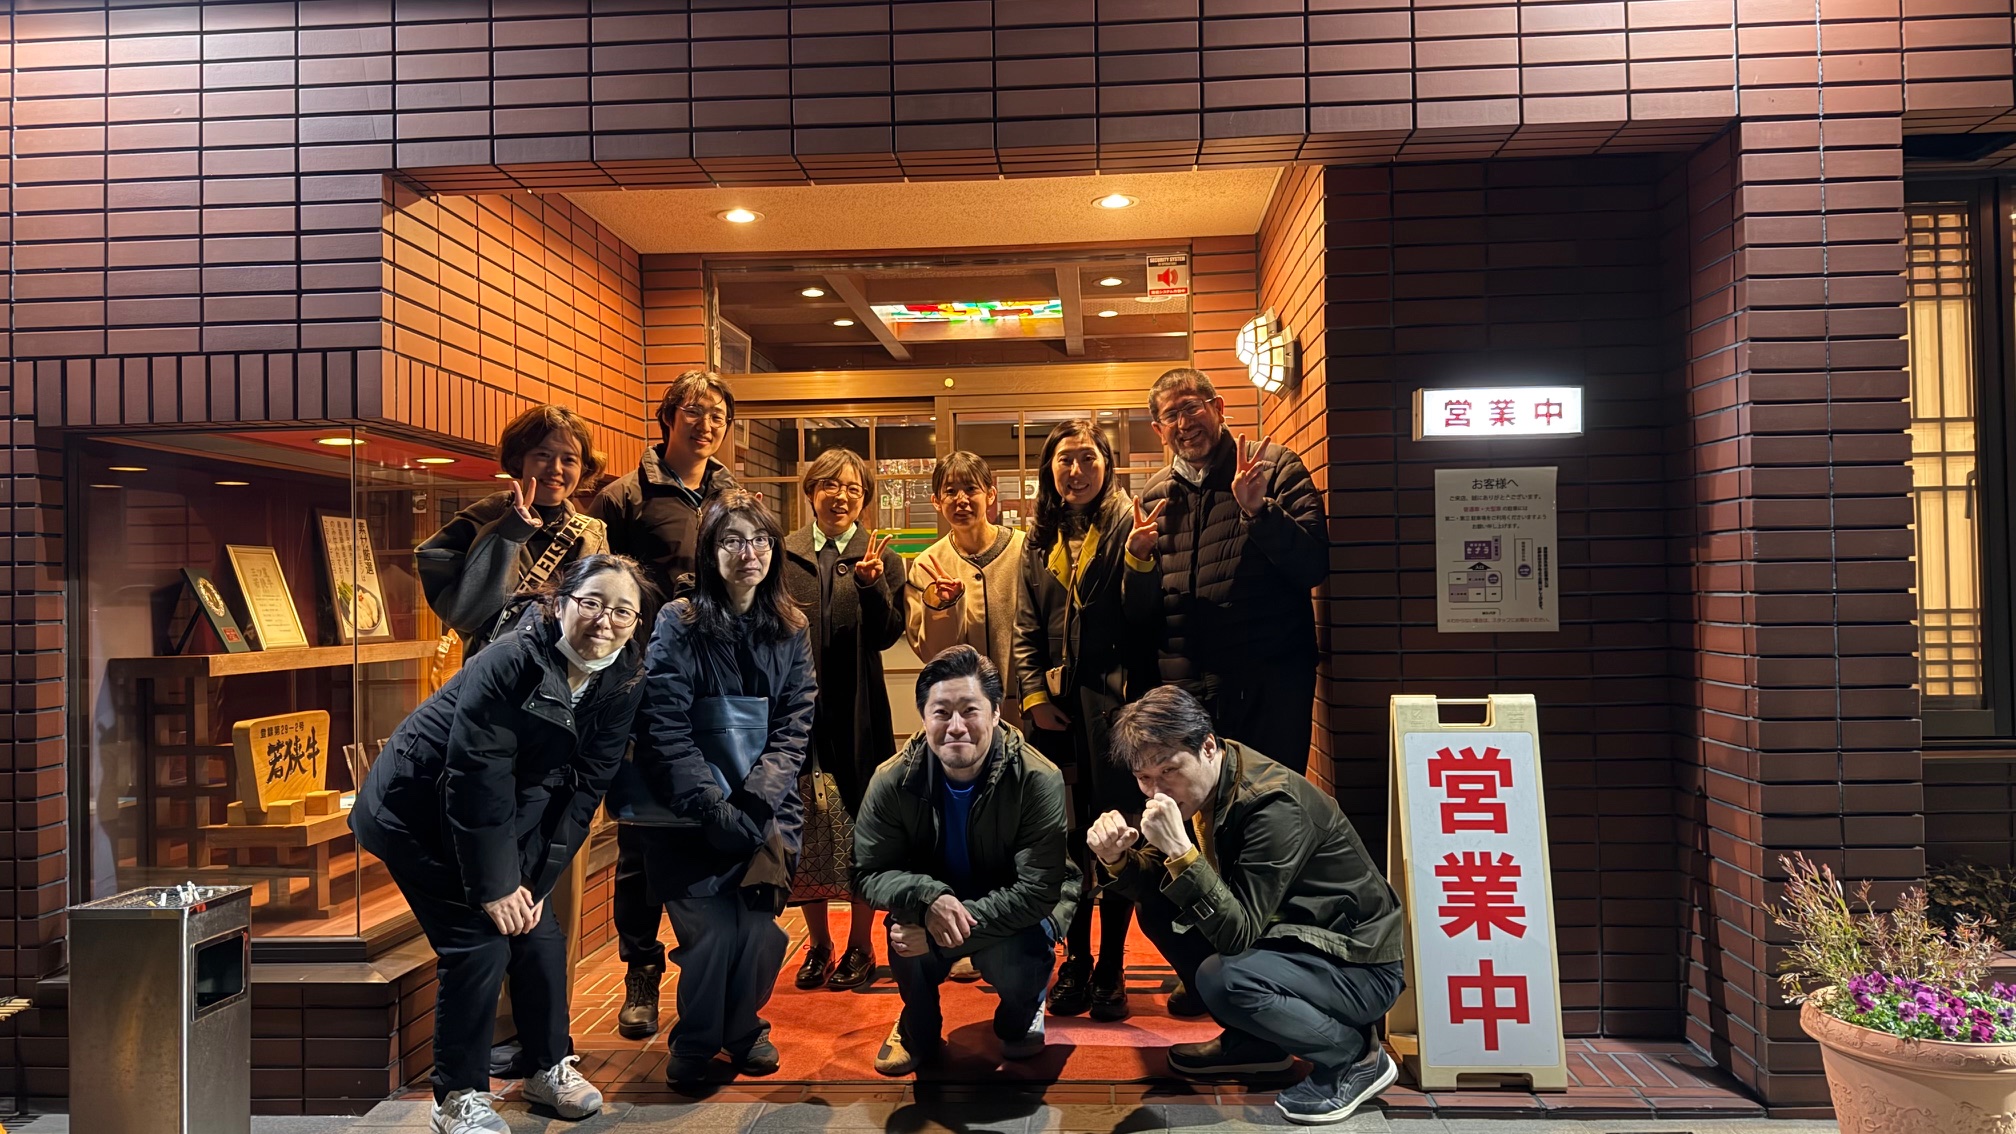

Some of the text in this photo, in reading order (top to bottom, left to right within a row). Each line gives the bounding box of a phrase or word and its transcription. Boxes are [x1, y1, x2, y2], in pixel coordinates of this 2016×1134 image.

[1444, 398, 1563, 427] 営業中
[1472, 478, 1519, 490] お客様へ
[357, 521, 374, 575] 素材は厳選
[266, 726, 320, 784] 若狭牛
[1427, 746, 1530, 1051] 営業中
